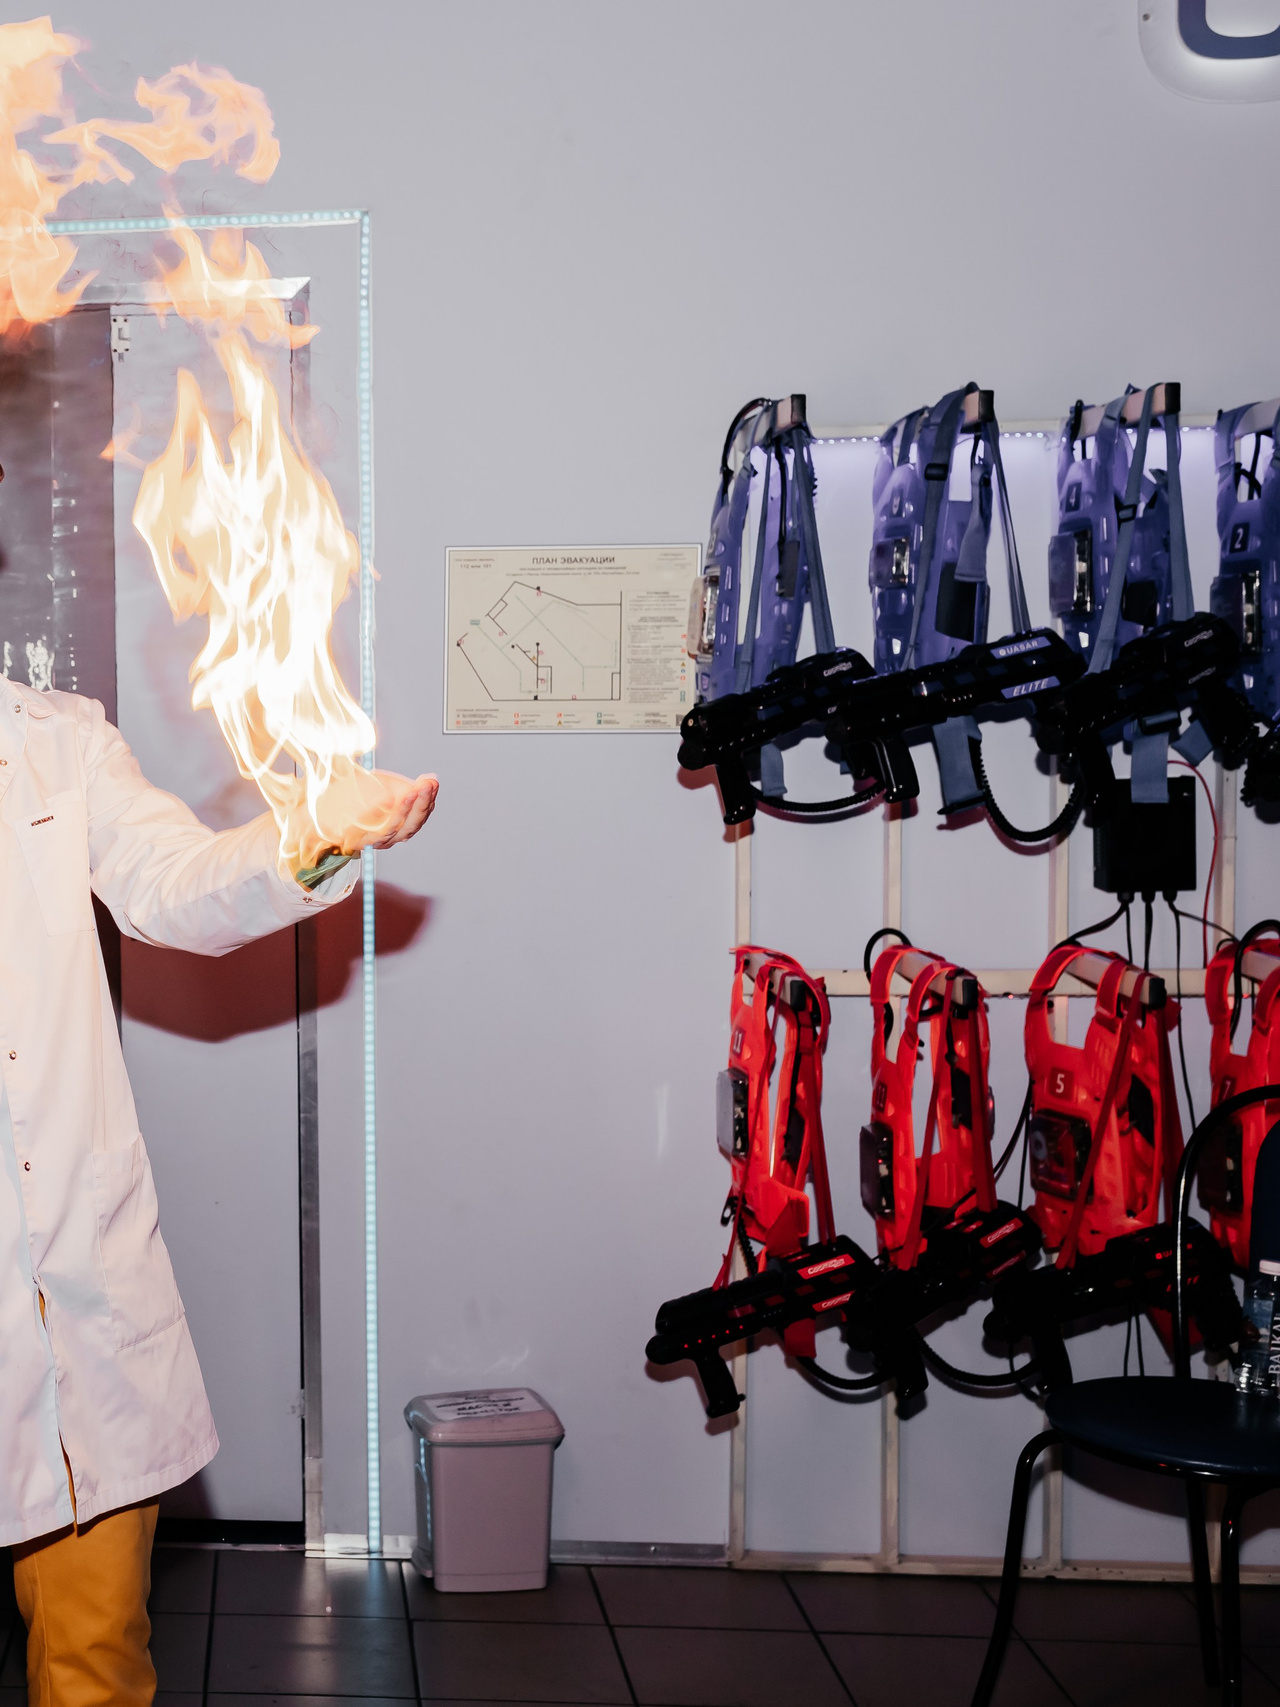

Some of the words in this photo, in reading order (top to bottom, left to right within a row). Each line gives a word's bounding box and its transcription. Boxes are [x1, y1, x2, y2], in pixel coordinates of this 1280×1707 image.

[1234, 528, 1244, 549] 2
[532, 557, 557, 565] ПЛАН
[560, 556, 616, 565] ЭВАКУАЦИИ
[998, 640, 1039, 657] QUASAR
[1012, 678, 1049, 697] ELITE
[1055, 1073, 1065, 1094] 5
